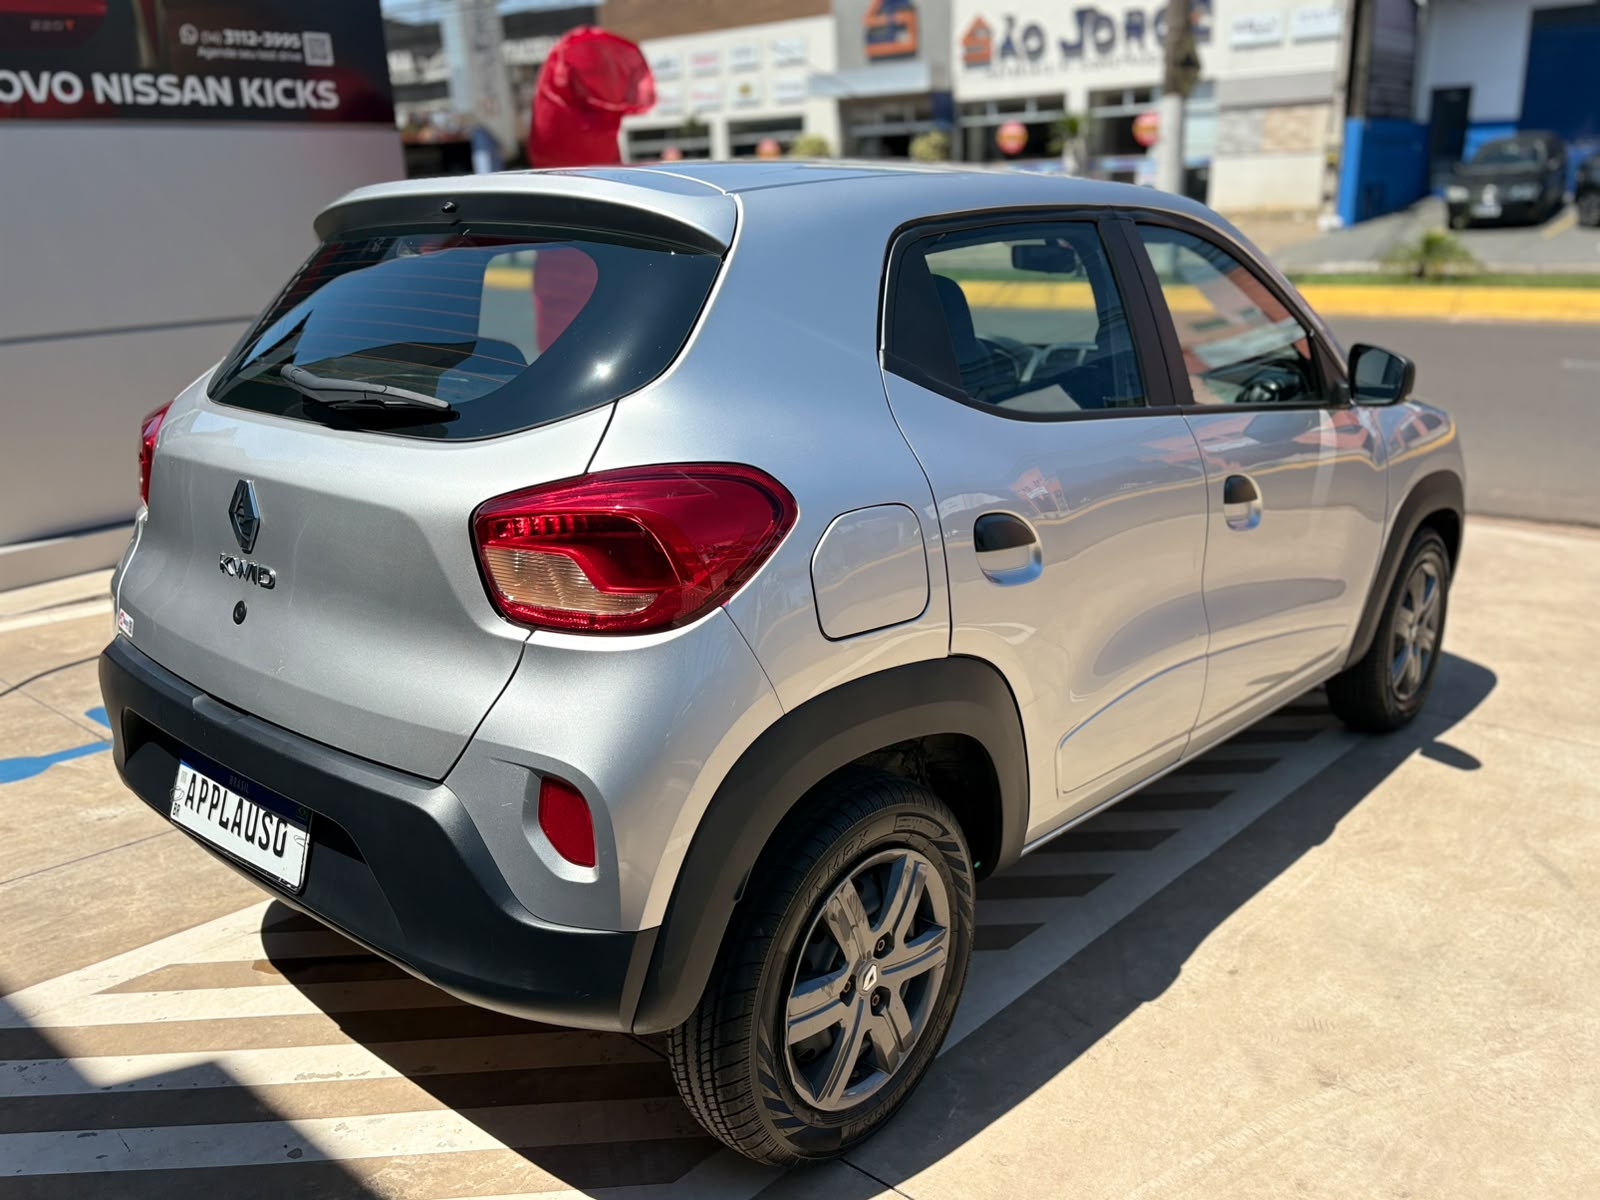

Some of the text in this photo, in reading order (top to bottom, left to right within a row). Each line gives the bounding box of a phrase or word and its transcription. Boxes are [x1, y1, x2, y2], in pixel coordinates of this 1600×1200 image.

[91, 72, 234, 107] NISSAN
[238, 76, 340, 111] KICKS
[219, 552, 277, 590] KWID
